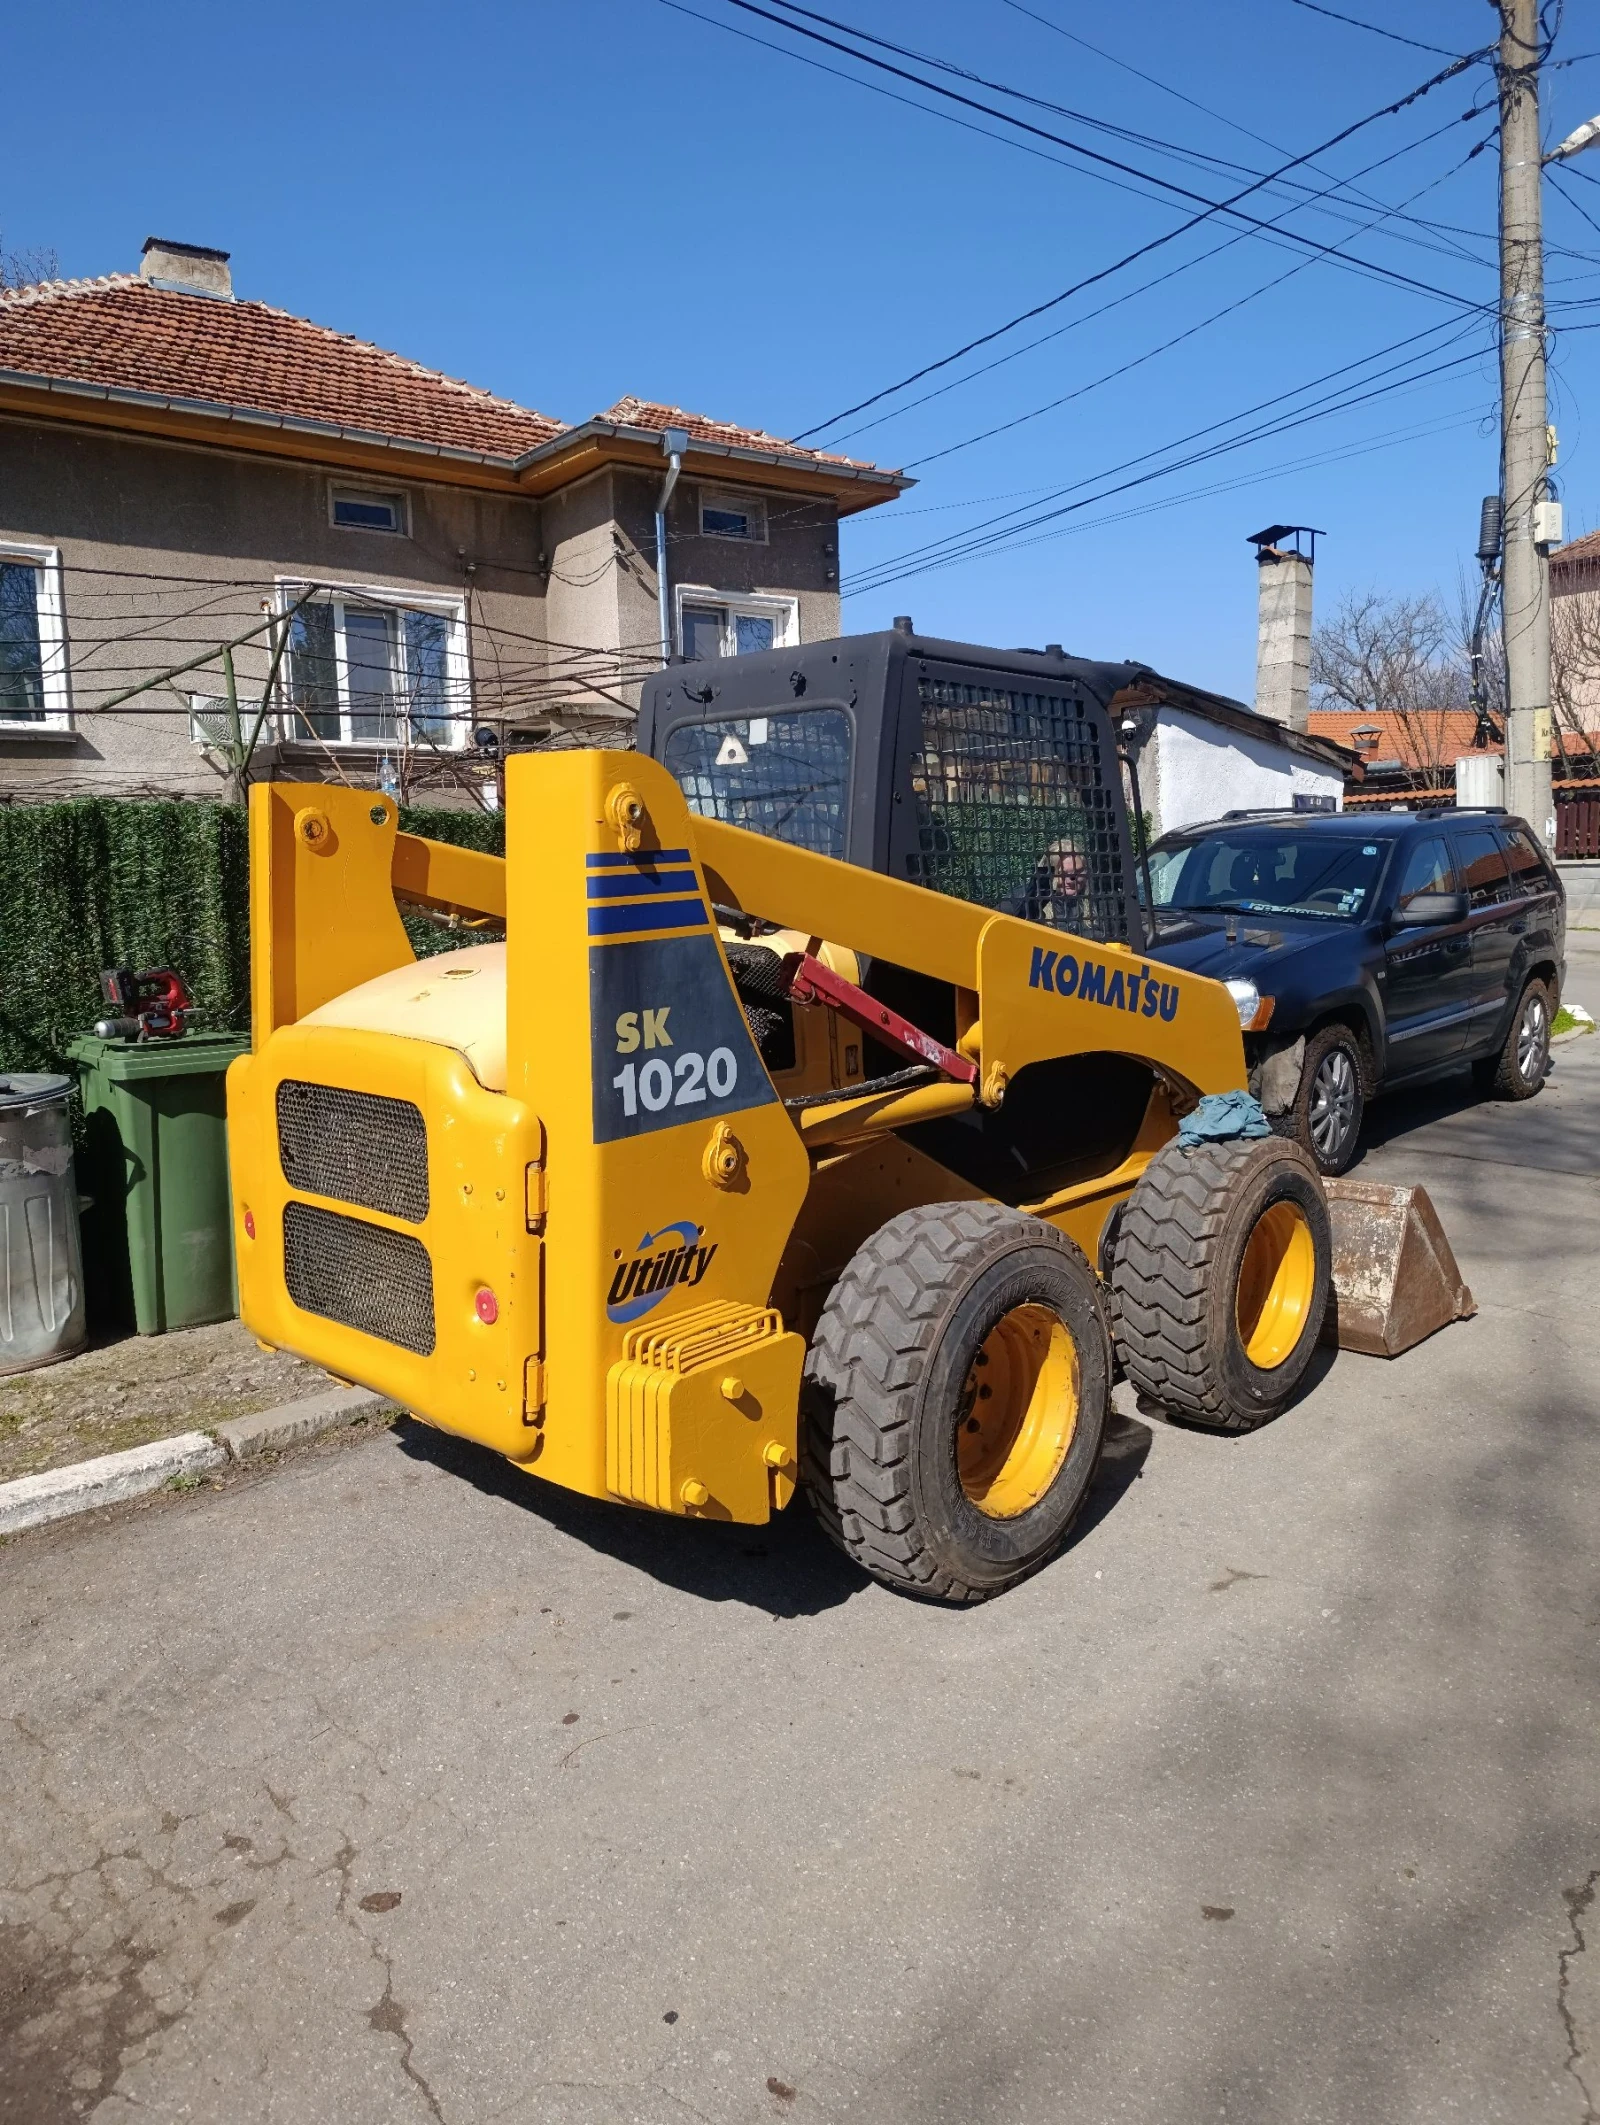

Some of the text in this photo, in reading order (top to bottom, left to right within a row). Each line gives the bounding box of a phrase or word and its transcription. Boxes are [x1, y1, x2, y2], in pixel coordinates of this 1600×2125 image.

[1028, 946, 1180, 1023] KOMATSU
[615, 1006, 674, 1054] SK
[613, 1046, 738, 1117] 1020
[606, 1243, 719, 1306] Utility
